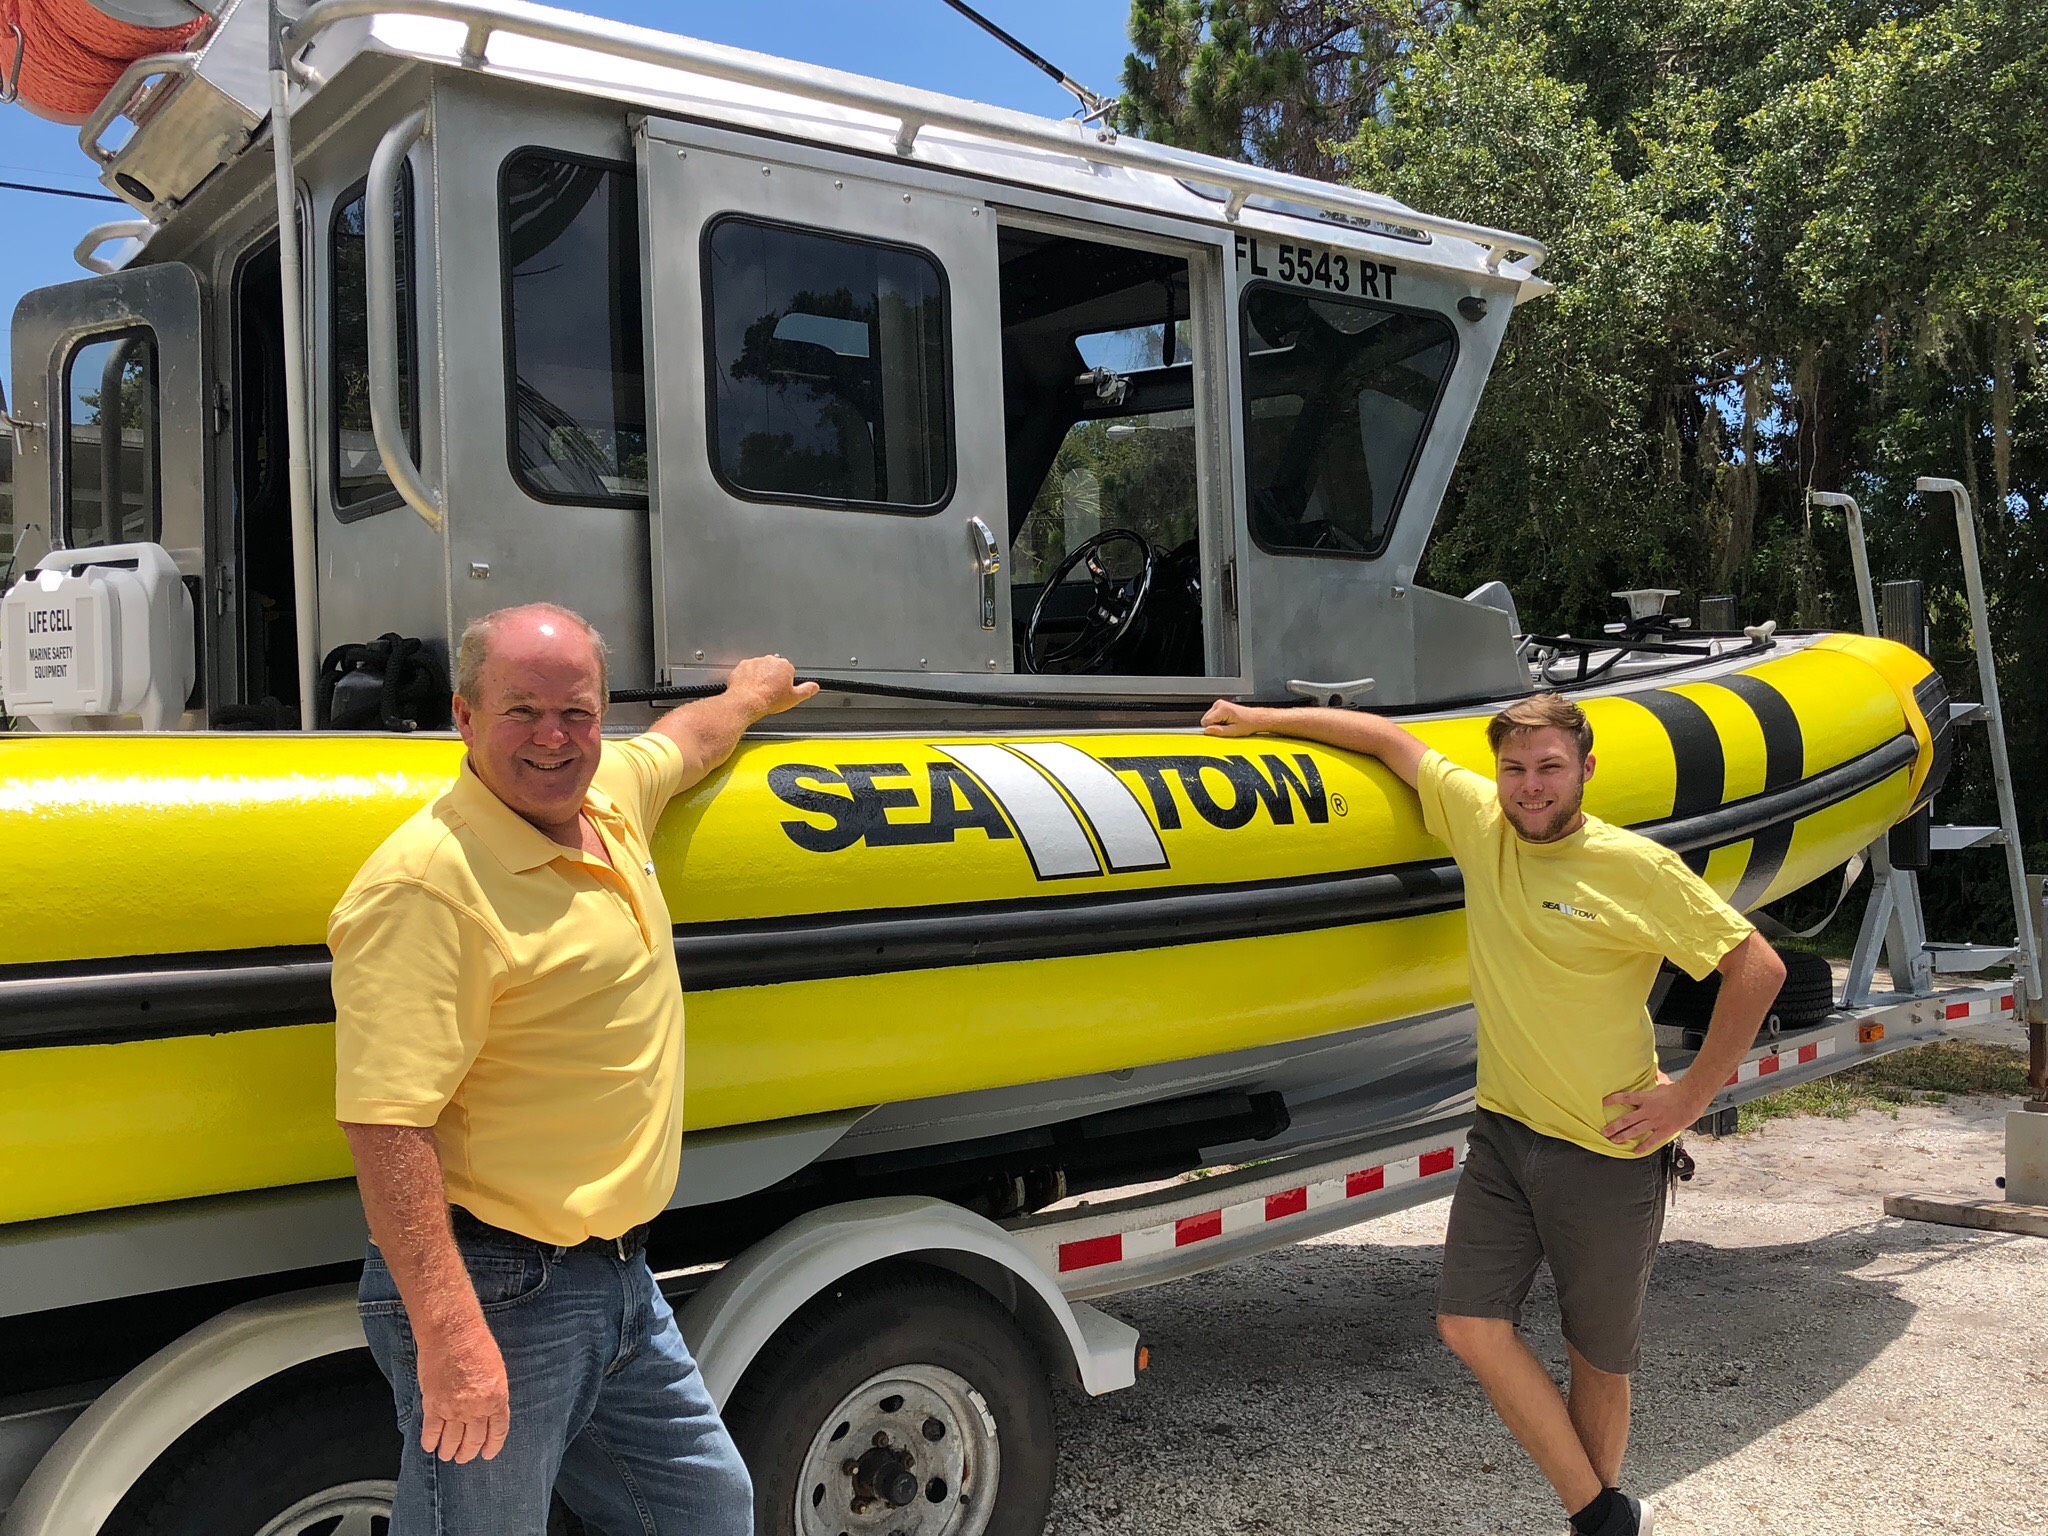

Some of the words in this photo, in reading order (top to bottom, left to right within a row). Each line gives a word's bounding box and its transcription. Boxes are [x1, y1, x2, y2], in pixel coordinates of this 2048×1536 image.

[1235, 235, 1268, 277] FL
[1278, 244, 1350, 292] 5543
[1360, 259, 1397, 300] RT
[28, 611, 48, 634] LIFE
[50, 609, 73, 632] CELL
[29, 647, 51, 661] MARINE
[52, 646, 73, 660] SAFETY
[34, 664, 67, 679] EQUIPMENT
[766, 761, 1016, 853] SEA
[1101, 753, 1330, 830] TOW
[1542, 901, 1561, 911] SEA
[1572, 908, 1597, 920] TOW
